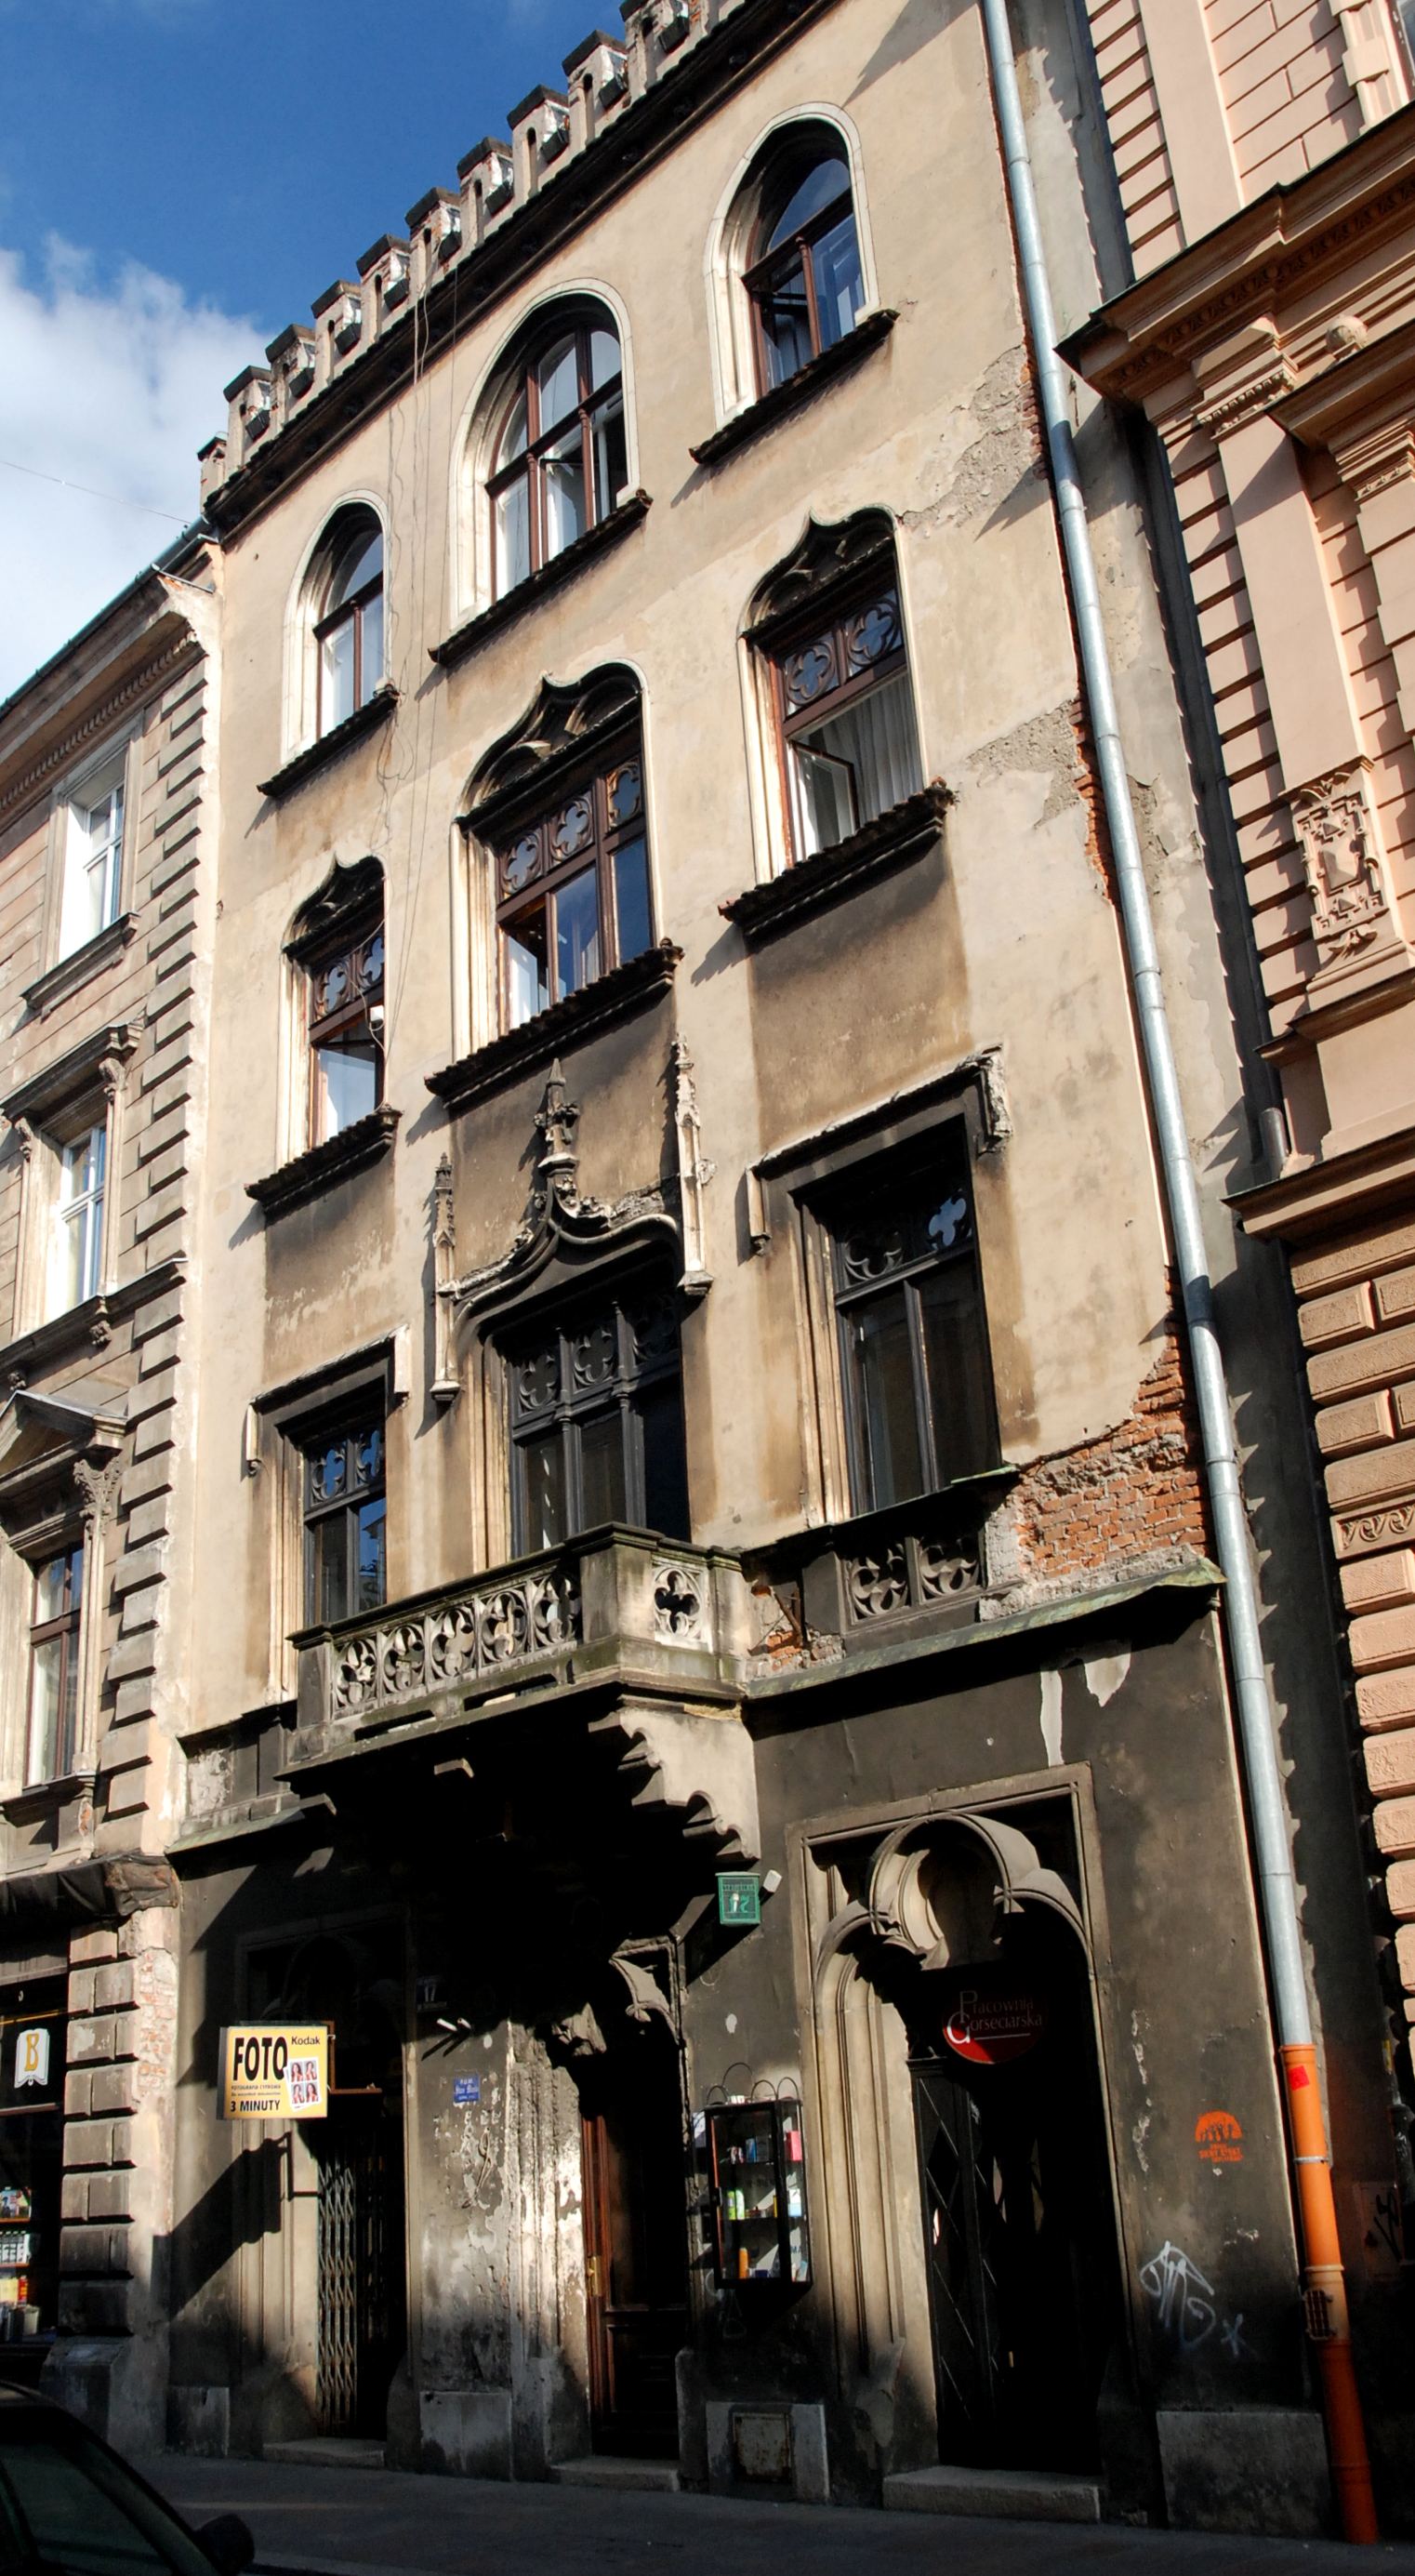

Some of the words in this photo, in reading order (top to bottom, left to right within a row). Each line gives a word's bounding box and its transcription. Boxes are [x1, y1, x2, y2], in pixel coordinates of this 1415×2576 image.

[959, 1989, 1034, 2024] Pracownia
[291, 2036, 320, 2045] Kodak
[946, 2008, 1042, 2044] Gorseciarska
[24, 2033, 39, 2072] B
[233, 2037, 288, 2081] FOTO
[230, 2101, 236, 2112] 3
[240, 2100, 281, 2111] MINUTY
